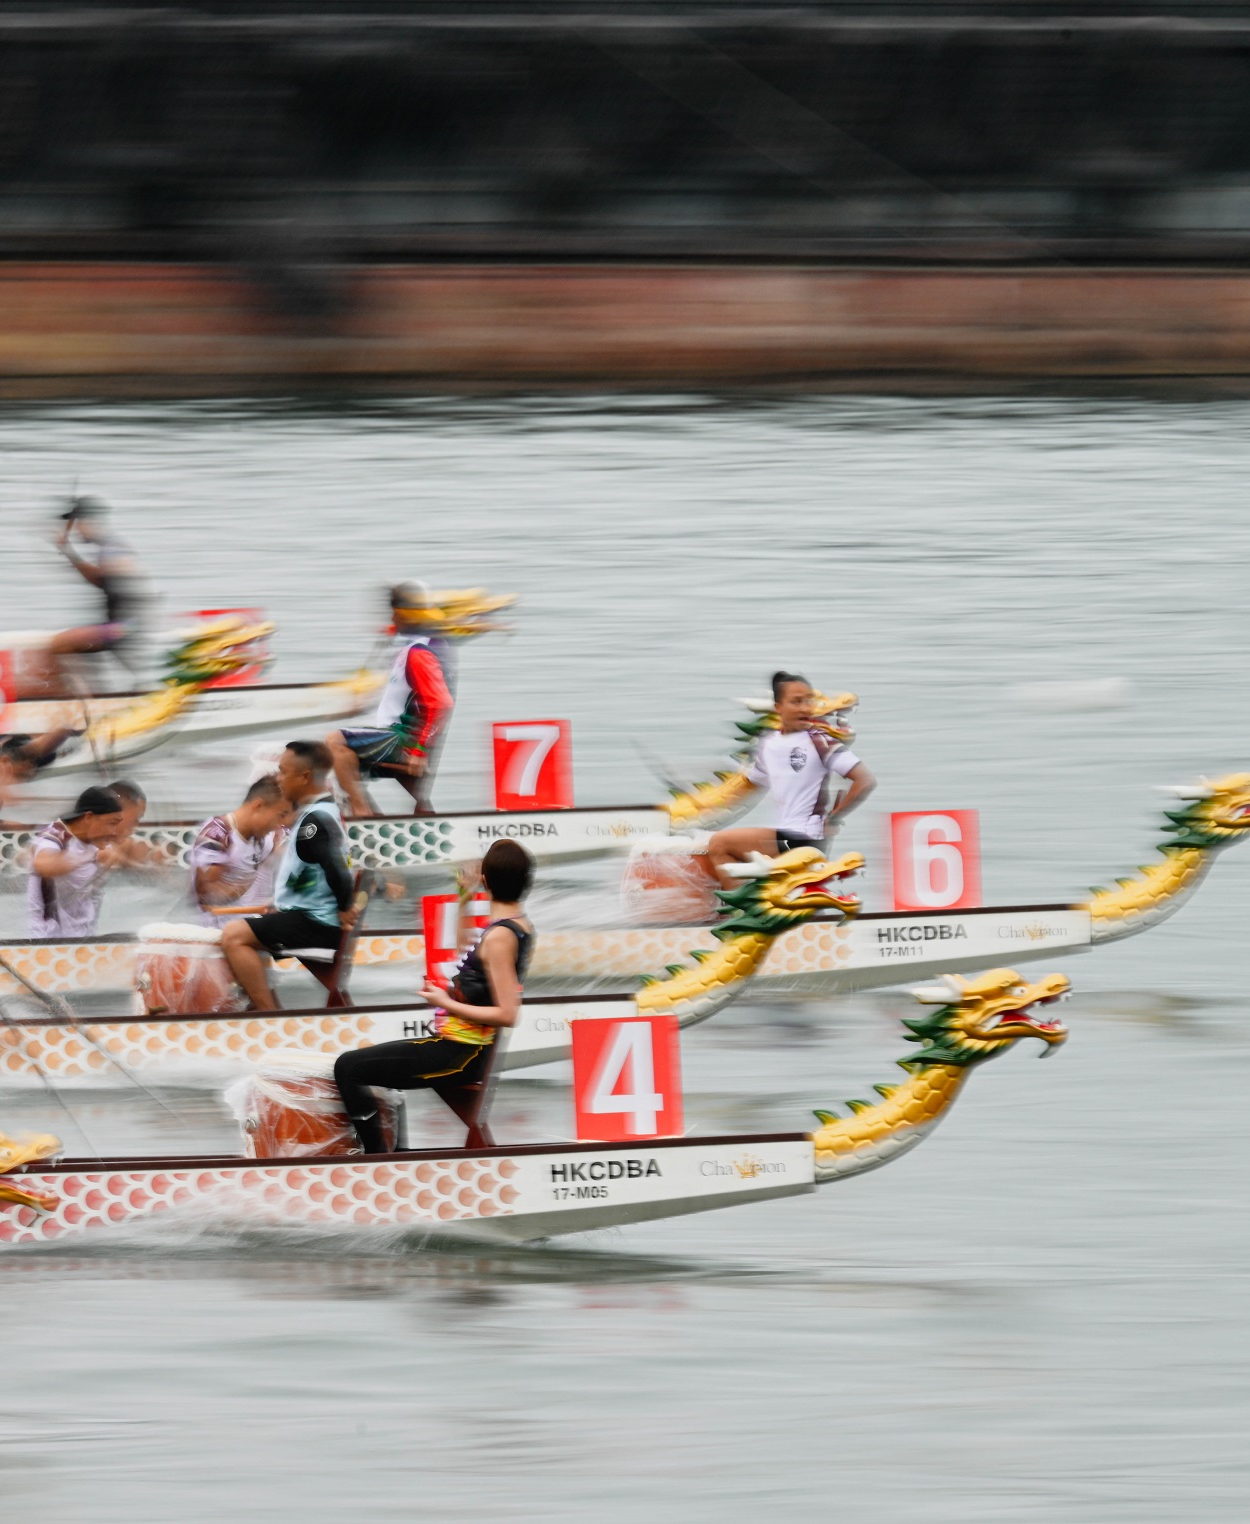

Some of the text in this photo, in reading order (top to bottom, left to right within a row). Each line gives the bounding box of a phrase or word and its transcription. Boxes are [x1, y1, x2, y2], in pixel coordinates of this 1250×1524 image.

[502, 725, 561, 797] 7
[477, 823, 559, 839] HKCDBA
[911, 814, 964, 908] 6
[877, 922, 1068, 943] HKCDBA Chapion
[878, 946, 924, 958] 17-M11
[586, 1021, 664, 1136] 4
[551, 1156, 787, 1183] HKCDBA Chapion
[552, 1186, 610, 1201] 17-M05
